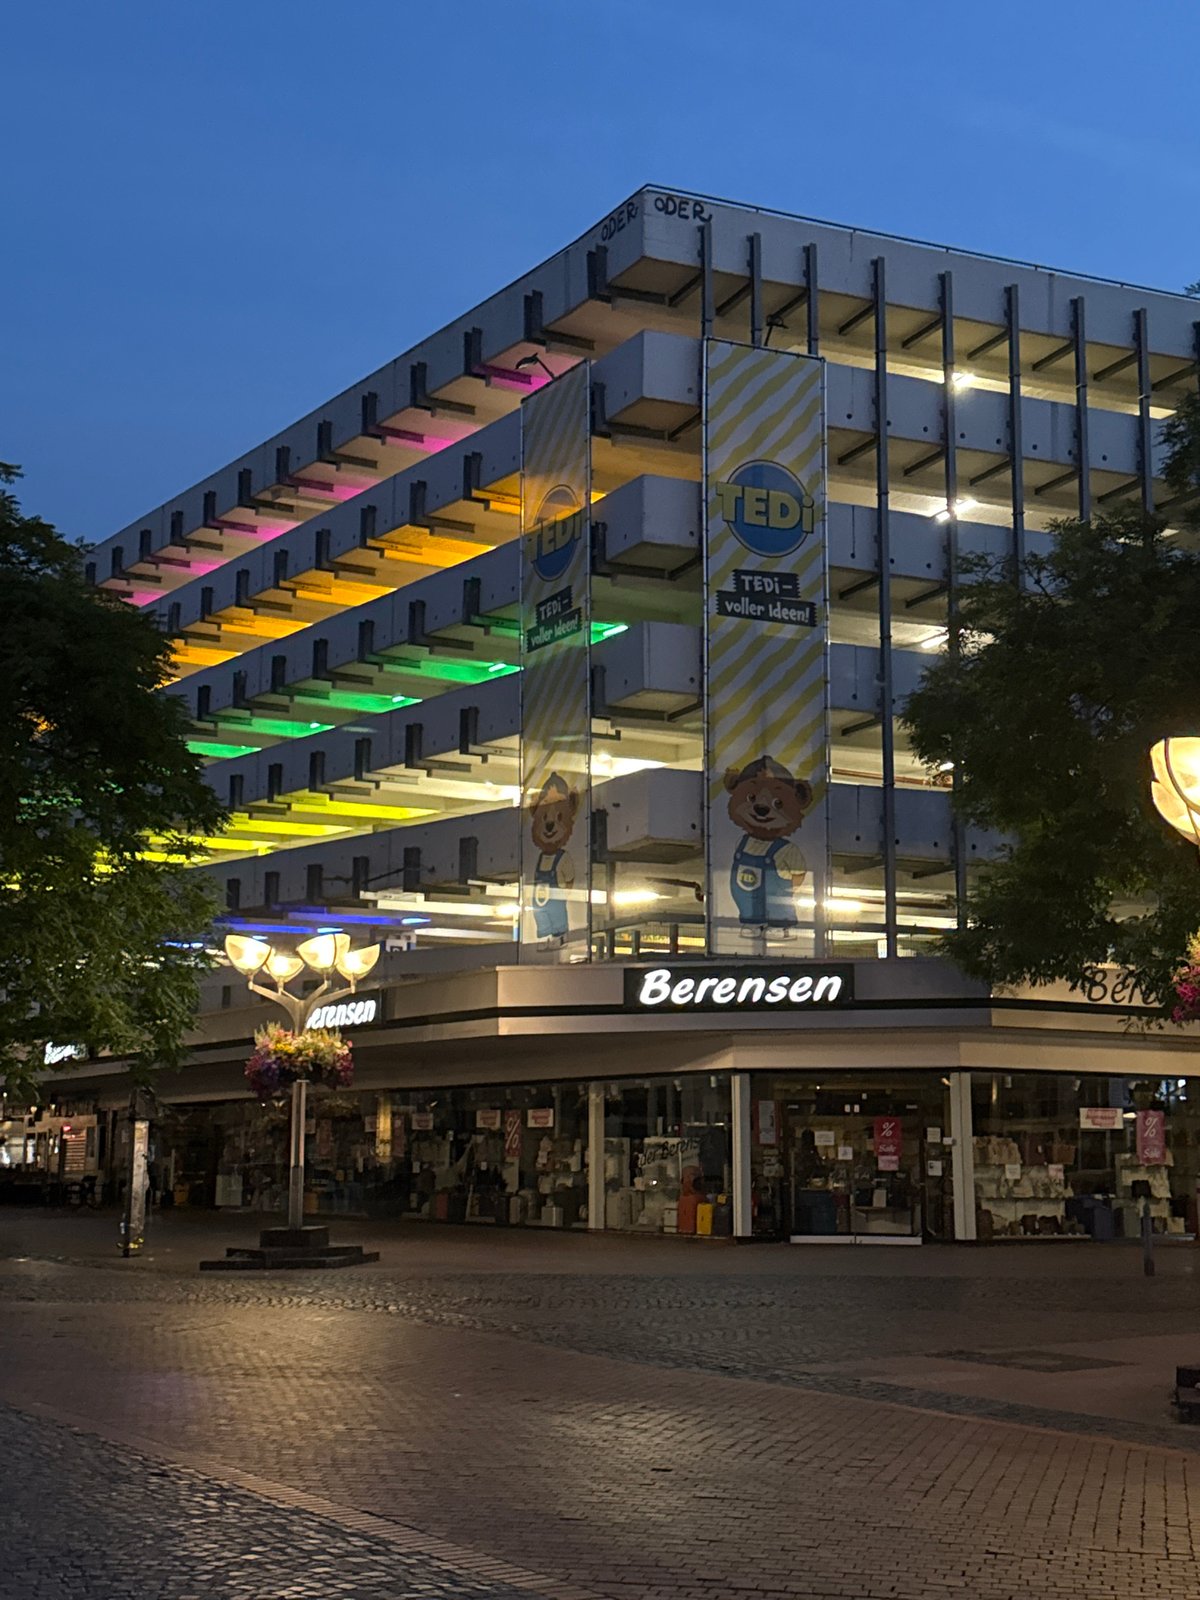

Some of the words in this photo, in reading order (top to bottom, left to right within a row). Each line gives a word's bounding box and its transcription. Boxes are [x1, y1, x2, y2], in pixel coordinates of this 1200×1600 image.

[601, 201, 638, 241] ODER
[654, 196, 712, 222] ODER
[715, 481, 814, 534] TEDi
[741, 575, 780, 594] TEDi
[725, 597, 765, 616] voller
[768, 602, 810, 623] Ideen!
[531, 624, 553, 647] voller
[639, 968, 843, 1005] Berensen
[306, 999, 377, 1029] erensen
